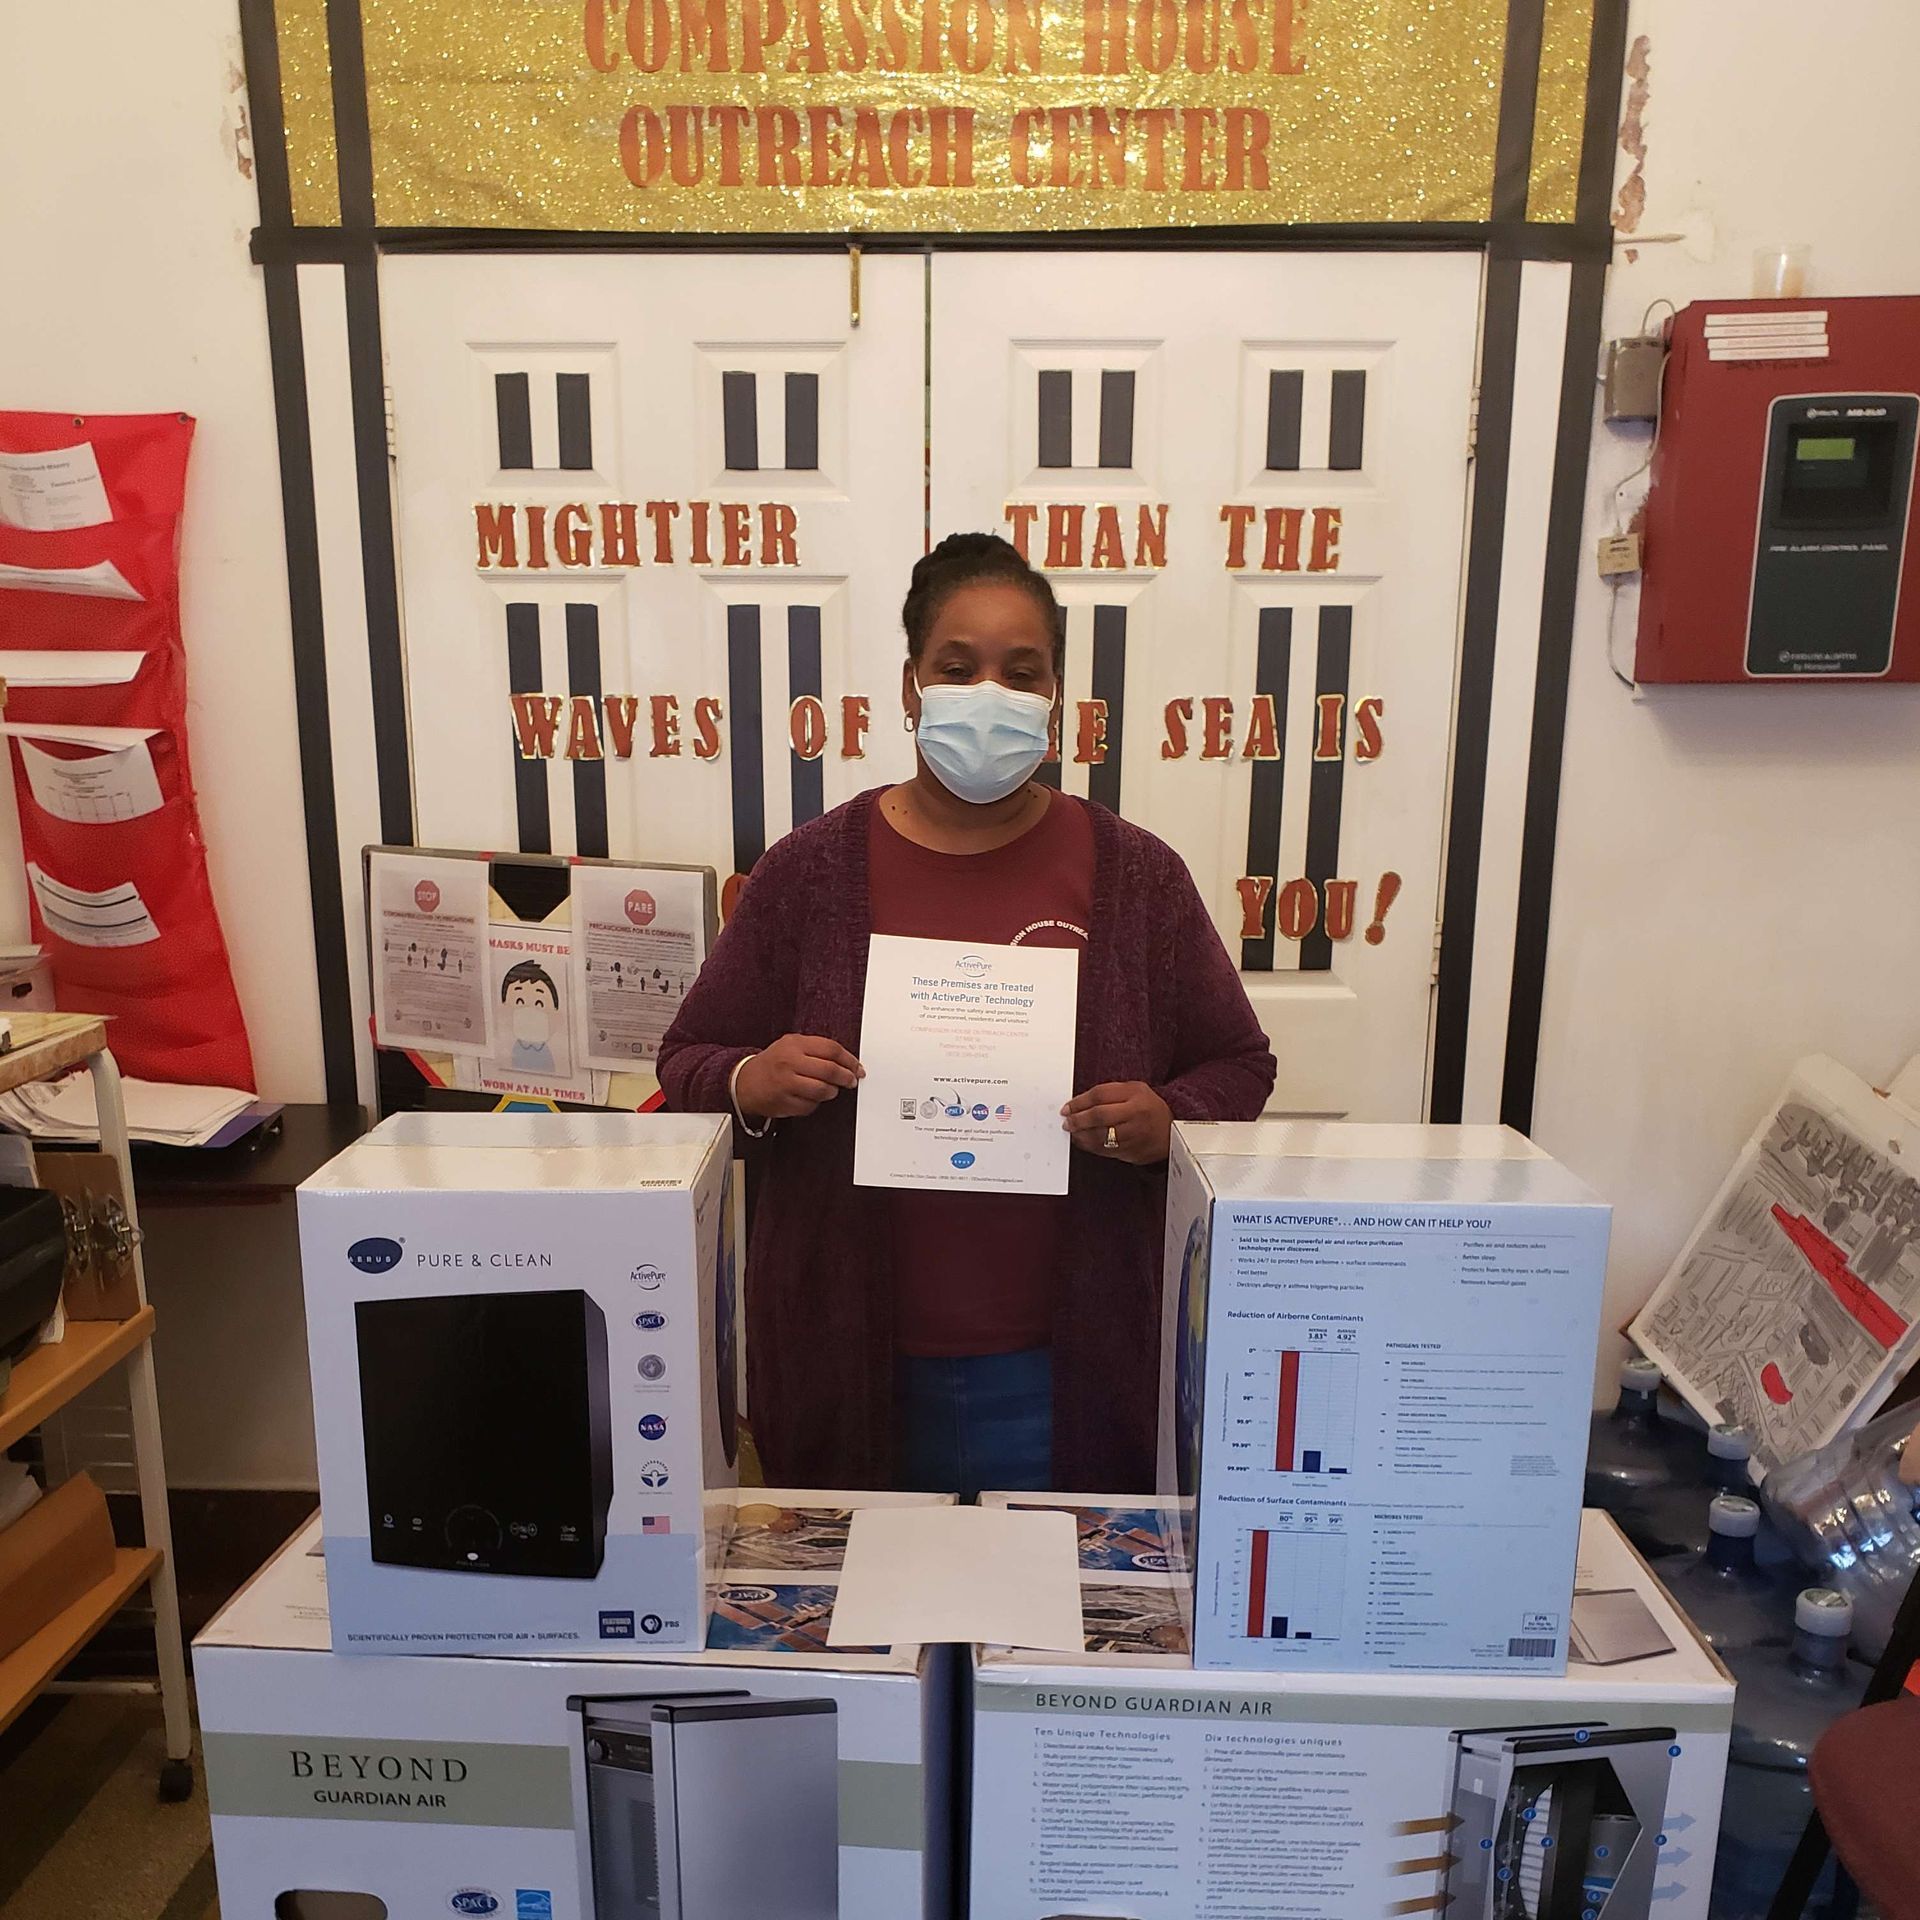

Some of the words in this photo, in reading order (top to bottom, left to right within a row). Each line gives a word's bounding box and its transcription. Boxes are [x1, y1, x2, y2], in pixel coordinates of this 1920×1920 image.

[585, 0, 1042, 74] COMPASSION
[1081, 0, 1307, 75] HOUSE
[619, 105, 975, 189] OUTREACH
[1011, 107, 1272, 191] CENTER
[474, 502, 800, 568] MIGHTIER
[1005, 501, 1170, 568] THAN
[1221, 504, 1343, 571] THE
[509, 693, 723, 761] WAVES
[789, 693, 870, 761] OF
[1160, 694, 1280, 762] SEA
[1316, 693, 1384, 762] IS
[628, 901, 653, 914] PARE
[1236, 871, 1401, 945] YOU!
[1025, 919, 1055, 933] HOUSE
[526, 941, 554, 953] MUST
[912, 977, 938, 987] These
[941, 979, 982, 990] Premises
[984, 983, 998, 991] are
[1000, 983, 1034, 993] Treated
[910, 991, 929, 1001] with
[985, 995, 1034, 1008] Technology
[933, 1077, 1009, 1085] www.activepure.com
[483, 1079, 514, 1091] WORN
[516, 1085, 530, 1094] AT
[532, 1086, 551, 1097] ALL
[554, 1089, 586, 1101] TIMES
[1233, 1214, 1262, 1224] WHAT
[1264, 1215, 1272, 1224] IS
[1353, 1217, 1375, 1226] AND
[1377, 1217, 1402, 1227] HOW
[1404, 1218, 1425, 1227] CAN
[1428, 1218, 1437, 1227] IT
[1439, 1219, 1463, 1228] HELP
[1466, 1219, 1491, 1229] YOU?
[417, 1254, 463, 1267] PURE
[472, 1254, 482, 1267] &
[490, 1254, 552, 1267] CLEAN
[631, 1271, 666, 1281] ActivePure
[1227, 1311, 1266, 1319] Reduction
[1277, 1312, 1309, 1320] Airborne
[1311, 1313, 1364, 1322] Contaminants
[1218, 1495, 1255, 1503] Reduction
[1295, 1498, 1346, 1507] Contaminants
[347, 1633, 409, 1641] SCIENTIFICALLY
[411, 1633, 443, 1641] PROVEN
[538, 1632, 579, 1640] SURFACES.
[1036, 1693, 1117, 1710] BEYOND
[1125, 1697, 1231, 1713] GUARDIAN
[1240, 1701, 1272, 1715] AIR
[1034, 1727, 1053, 1735] Ten
[1057, 1729, 1095, 1738] Unique
[1099, 1730, 1171, 1741] Technologies
[1205, 1734, 1221, 1742] Dix
[1226, 1735, 1295, 1745] technologies
[1300, 1738, 1342, 1746] uniques
[289, 1750, 468, 1782] BEYOND
[313, 1789, 411, 1806] GUARDIAN
[416, 1794, 447, 1808] AIR
